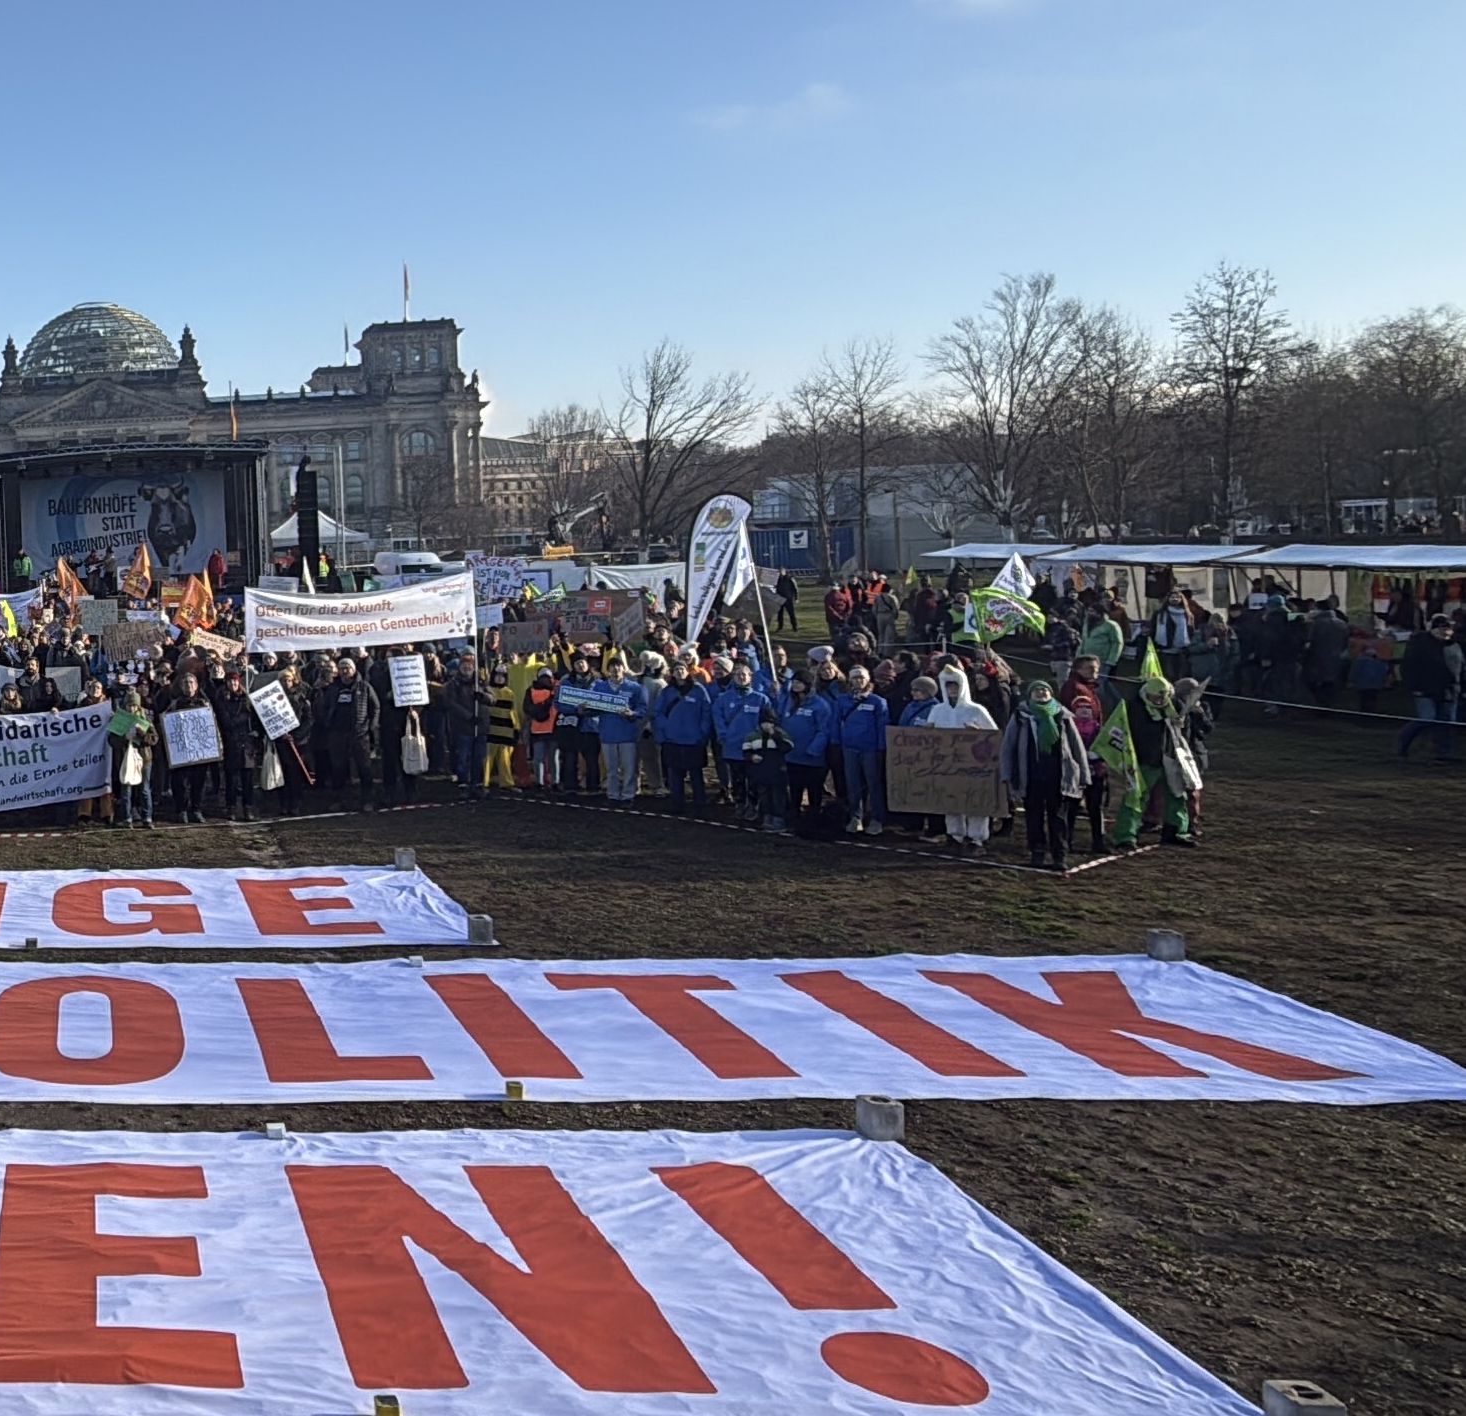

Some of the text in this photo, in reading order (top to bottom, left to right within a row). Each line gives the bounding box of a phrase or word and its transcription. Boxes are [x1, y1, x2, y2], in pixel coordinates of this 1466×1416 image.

[48, 493, 137, 516] BAUERNHÖFE
[102, 515, 136, 531] STATT
[51, 529, 147, 557] AGRARINDUSTRIE!
[256, 600, 395, 618] Offen für die Zukunft,
[256, 612, 455, 641] geschlossen gegen Gentechnik!
[10, 770, 29, 785] die
[34, 763, 68, 781] Ernte
[73, 752, 105, 770] teilen
